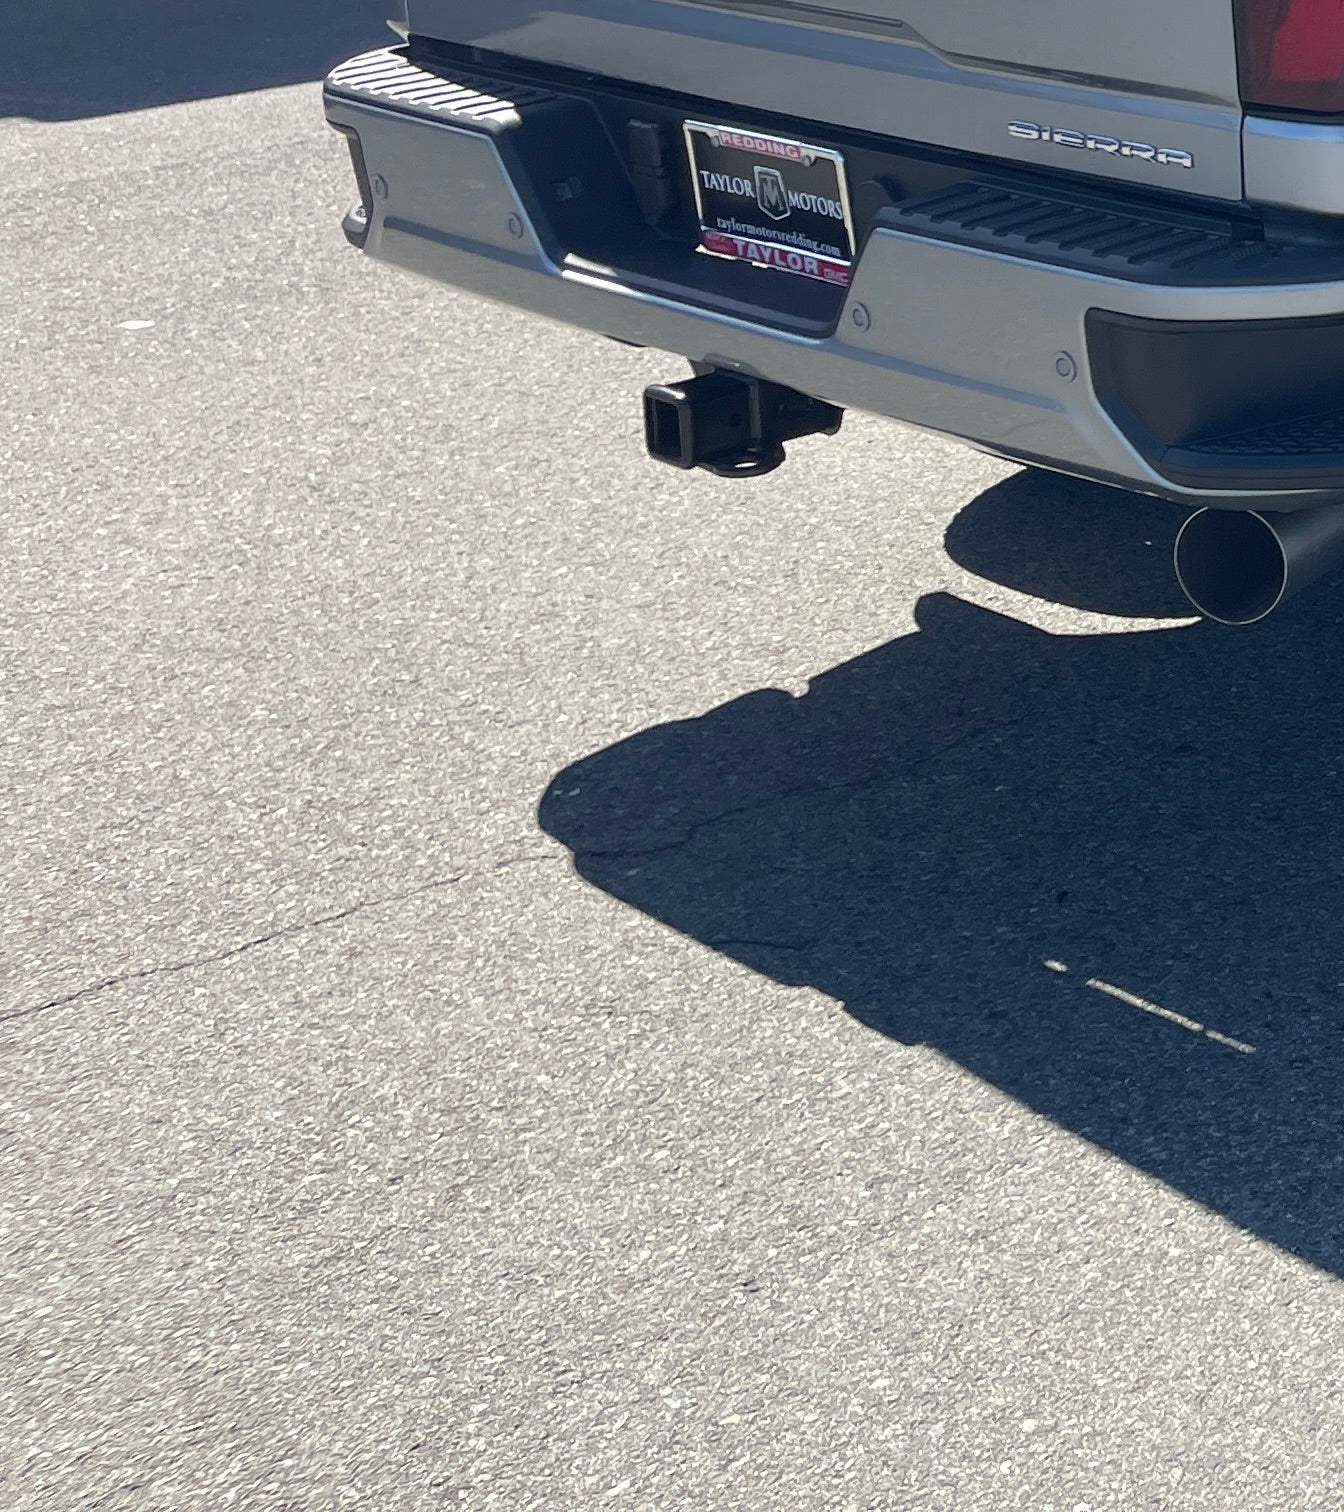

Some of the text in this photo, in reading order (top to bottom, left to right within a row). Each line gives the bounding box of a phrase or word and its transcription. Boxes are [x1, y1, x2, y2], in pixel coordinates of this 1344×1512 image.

[719, 131, 800, 159] REDDING
[1007, 119, 1194, 169] SIERRA
[700, 170, 757, 199] TAYLOR
[787, 190, 845, 220] MOTORS
[716, 216, 841, 257] taylormotorsredding.com
[732, 238, 819, 275] TAYLOR
